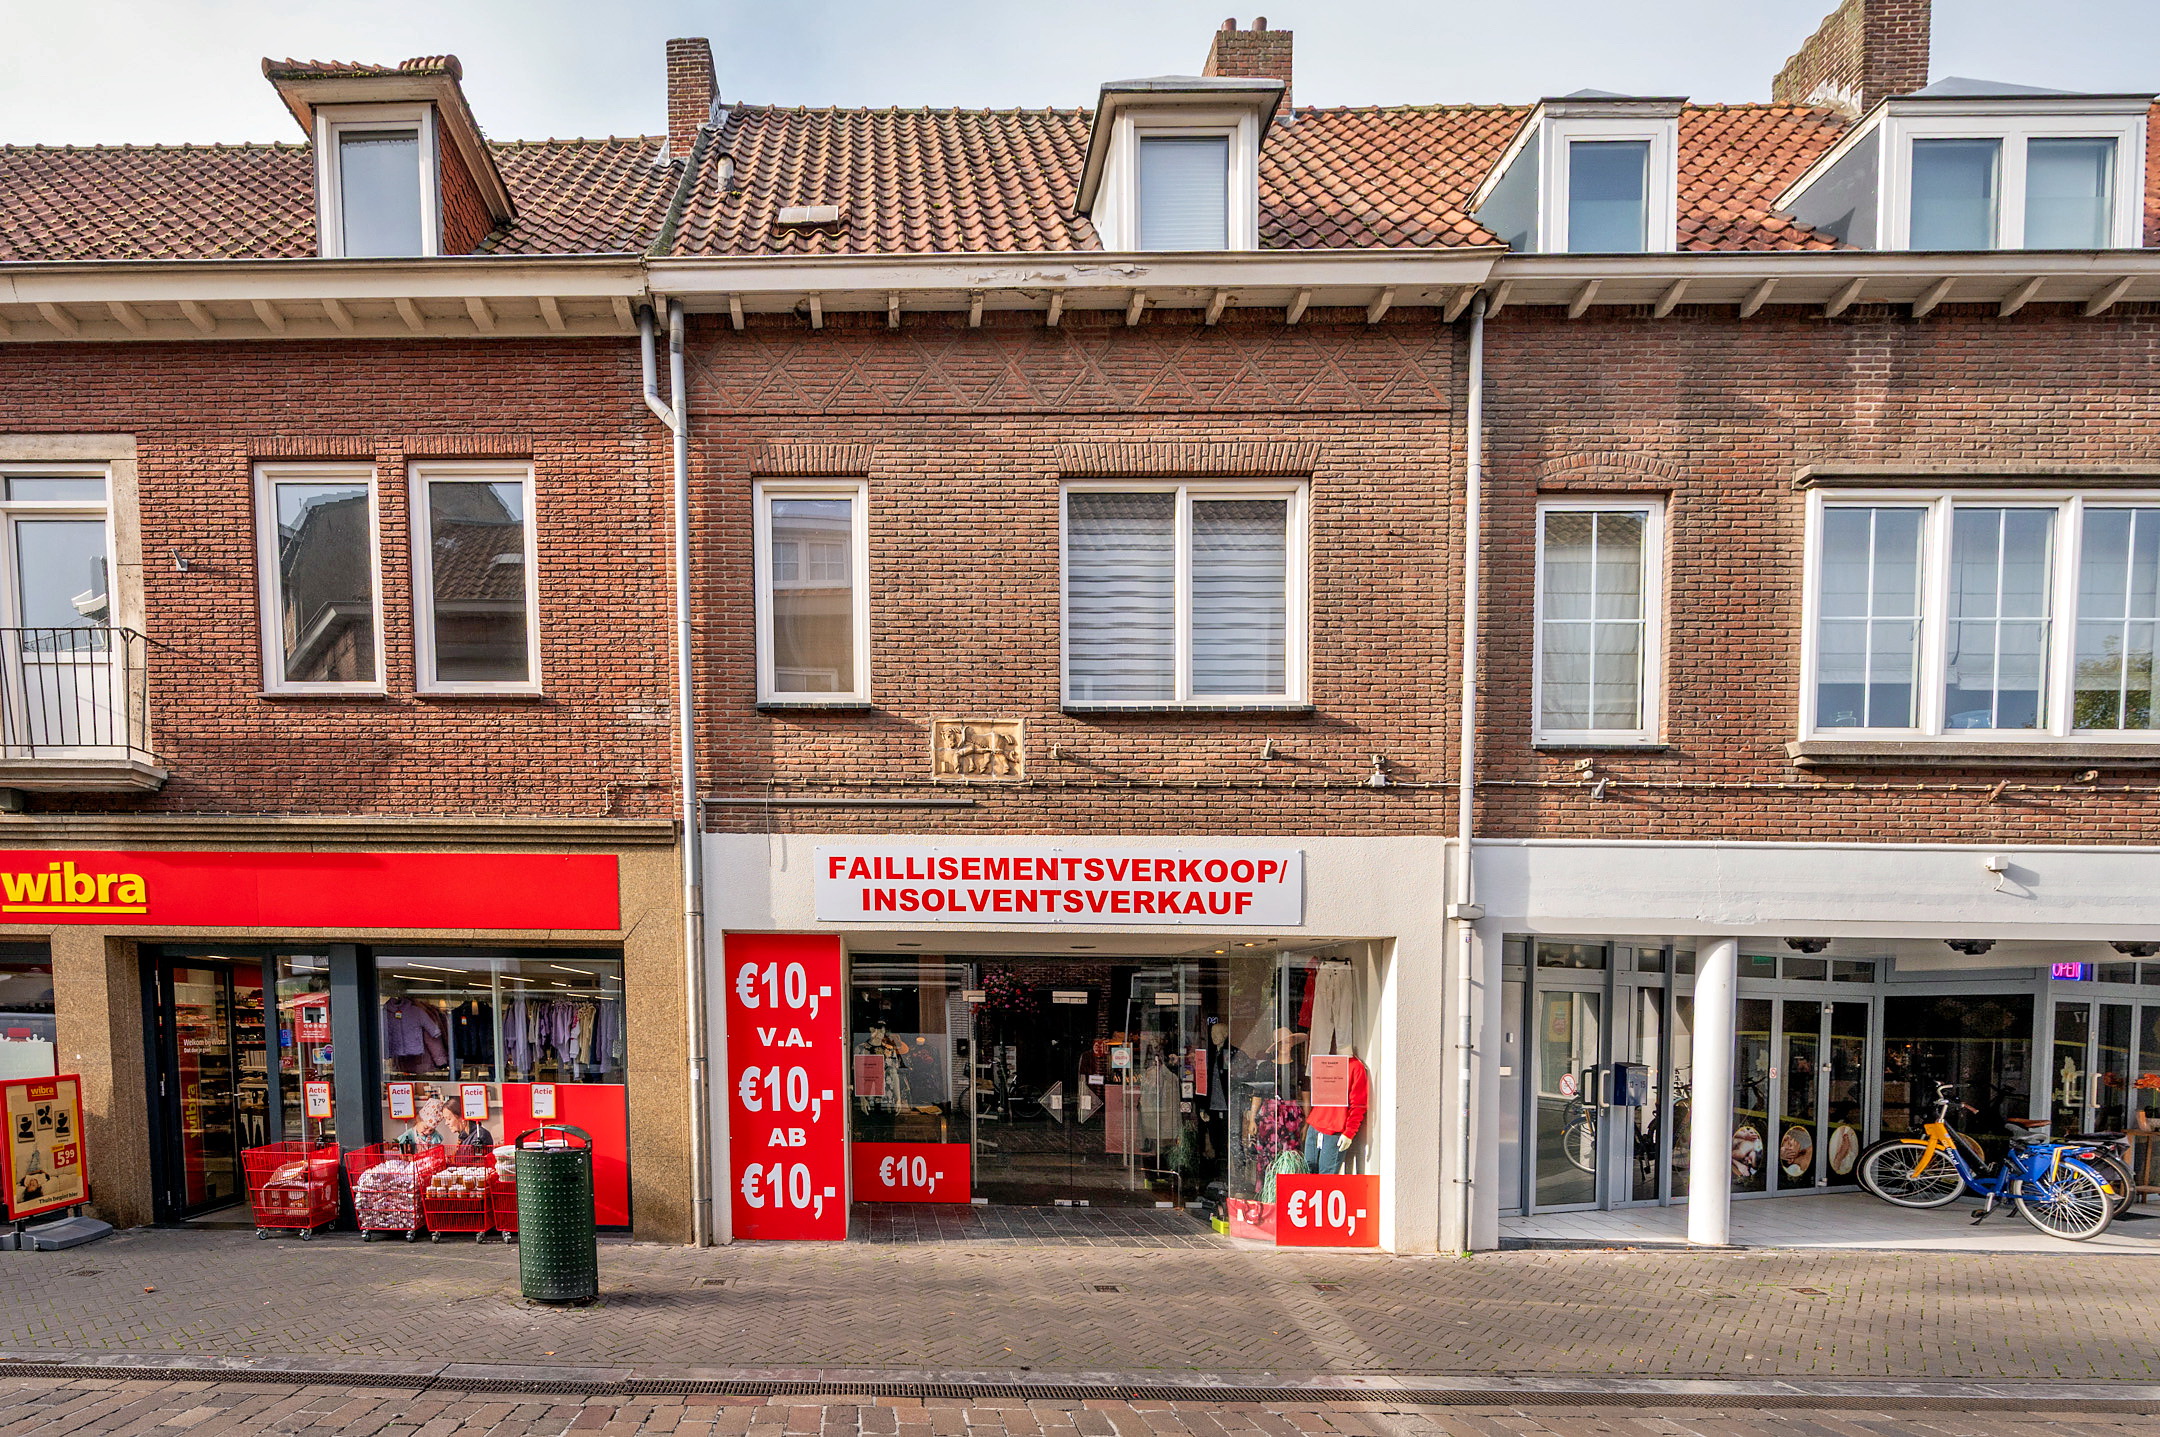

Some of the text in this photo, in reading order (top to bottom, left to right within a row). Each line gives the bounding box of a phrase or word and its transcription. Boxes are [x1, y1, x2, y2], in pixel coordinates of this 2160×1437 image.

[1, 862, 147, 903] wibra
[829, 857, 1288, 883] FAILLISEMENTSVERKOOP/
[863, 889, 1252, 915] INSOLVENTSVERKAUF
[736, 963, 832, 1019] €10,-
[757, 1028, 813, 1047] V.A.
[31, 1086, 55, 1095] wibra
[309, 1086, 327, 1094] Actie
[739, 1066, 834, 1122] €10,-
[186, 1083, 198, 1139] wibra
[768, 1128, 807, 1146] AB
[742, 1163, 835, 1220] €10,-
[880, 1156, 944, 1194] €10,-
[1288, 1190, 1367, 1237] €10,-
